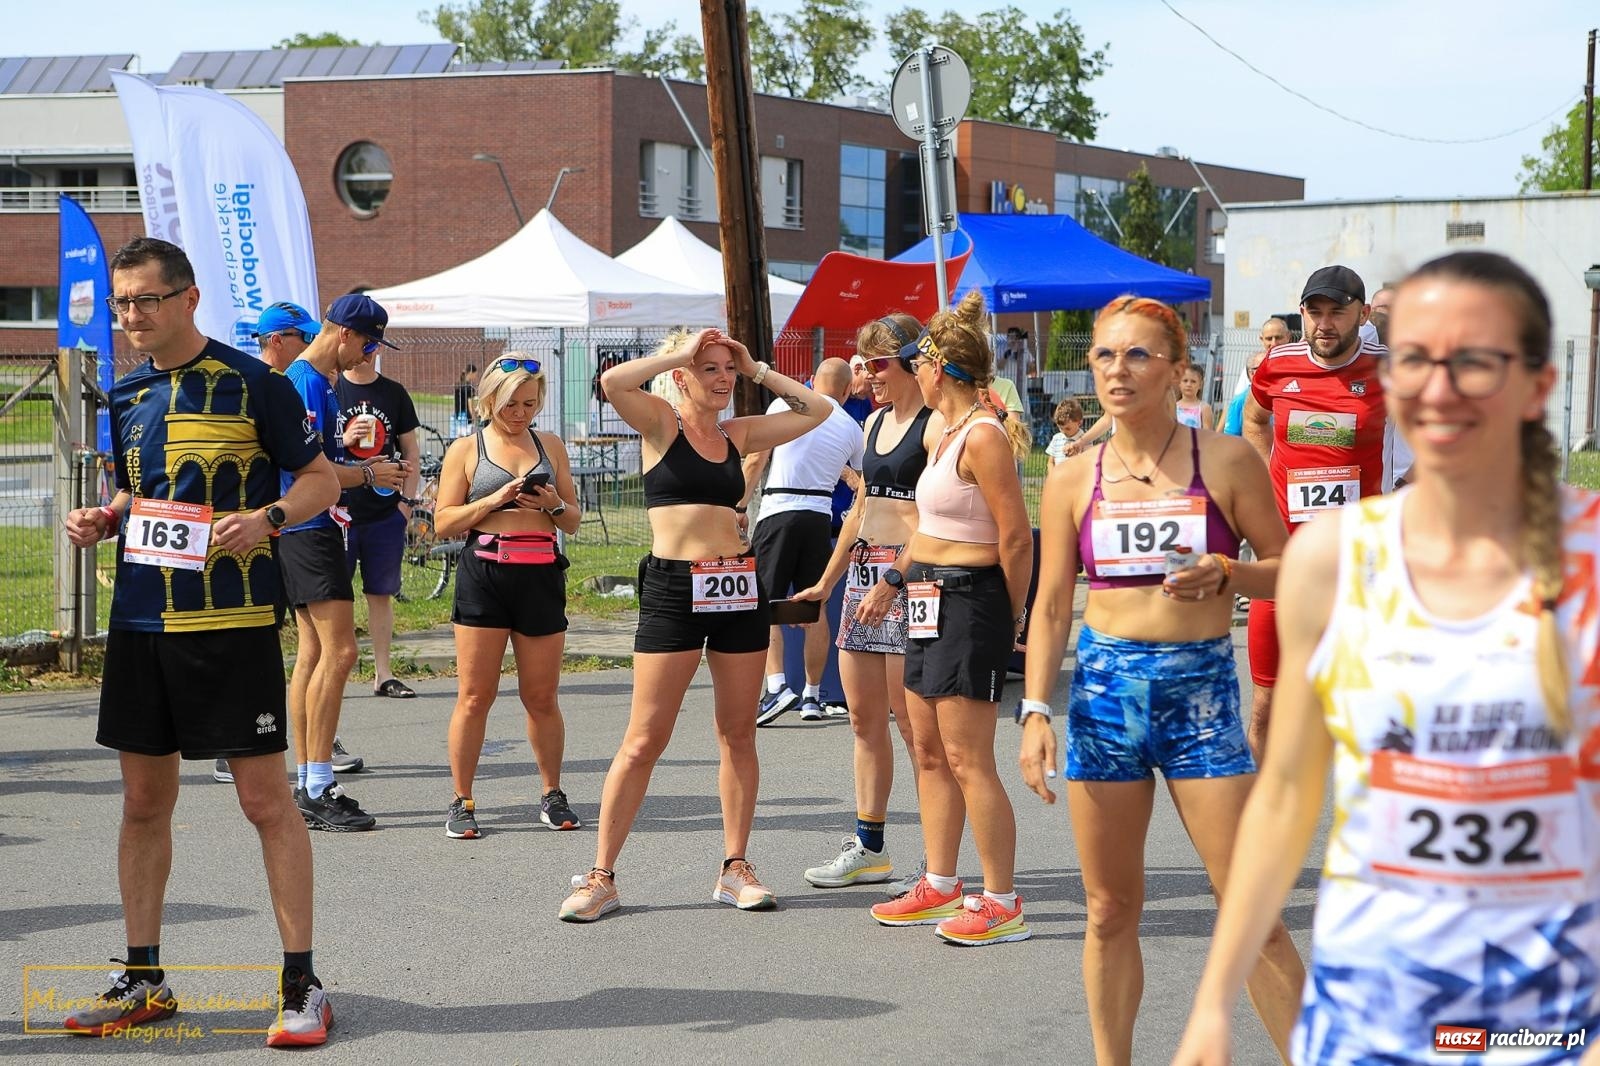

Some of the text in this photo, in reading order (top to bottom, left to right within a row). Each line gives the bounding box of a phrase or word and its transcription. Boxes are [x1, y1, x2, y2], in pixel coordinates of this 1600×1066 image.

[1351, 385, 1365, 394] KS
[372, 406, 392, 431] WAVE
[1300, 484, 1346, 507] 124
[141, 520, 190, 550] 163
[1117, 521, 1180, 553] 192
[705, 575, 748, 598] 200
[854, 566, 878, 587] 191
[1408, 809, 1542, 865] 232
